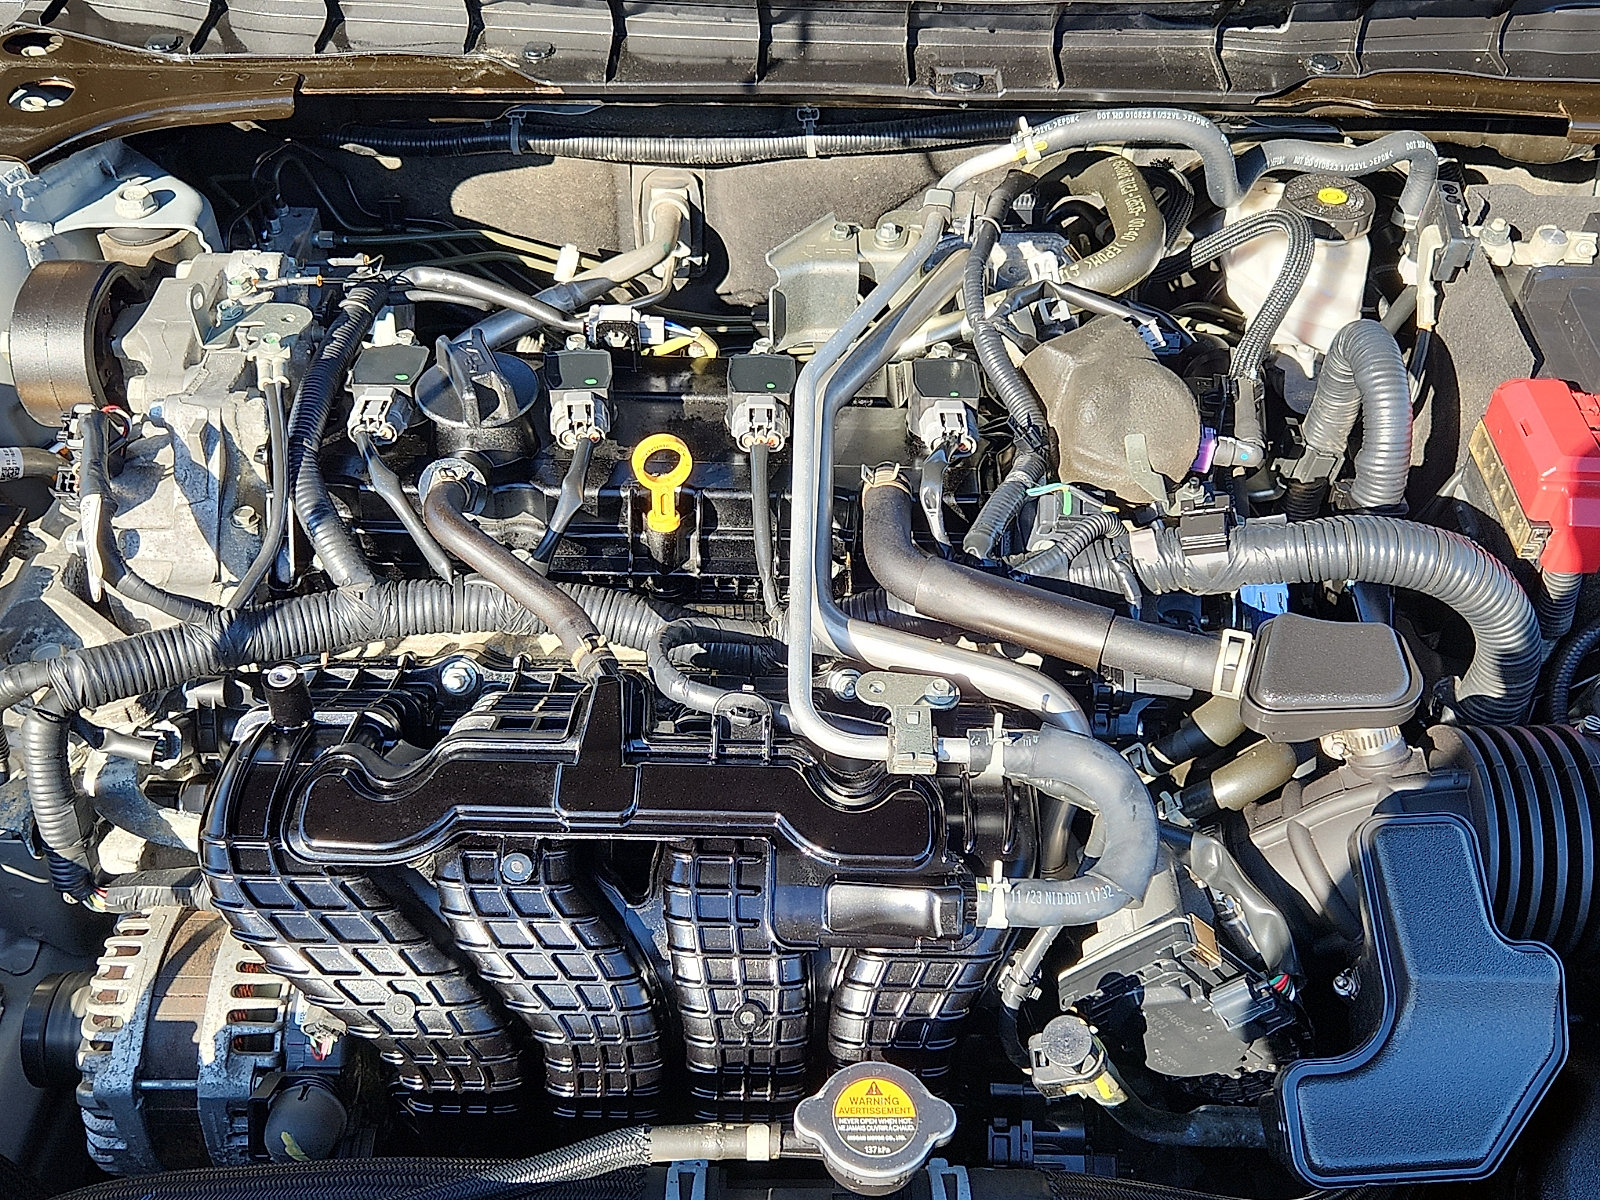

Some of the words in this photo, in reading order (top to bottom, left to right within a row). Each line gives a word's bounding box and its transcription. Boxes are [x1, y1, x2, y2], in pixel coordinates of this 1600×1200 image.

[1096, 111, 1110, 120] DOT
[1045, 891, 1063, 906] NID
[1065, 891, 1082, 905] DOT
[1084, 885, 1114, 905] 11/32
[849, 1096, 900, 1106] WARNING
[838, 1107, 911, 1115] AVERTISSEMENT
[864, 1146, 877, 1154] 137
[878, 1146, 892, 1154] kPa
